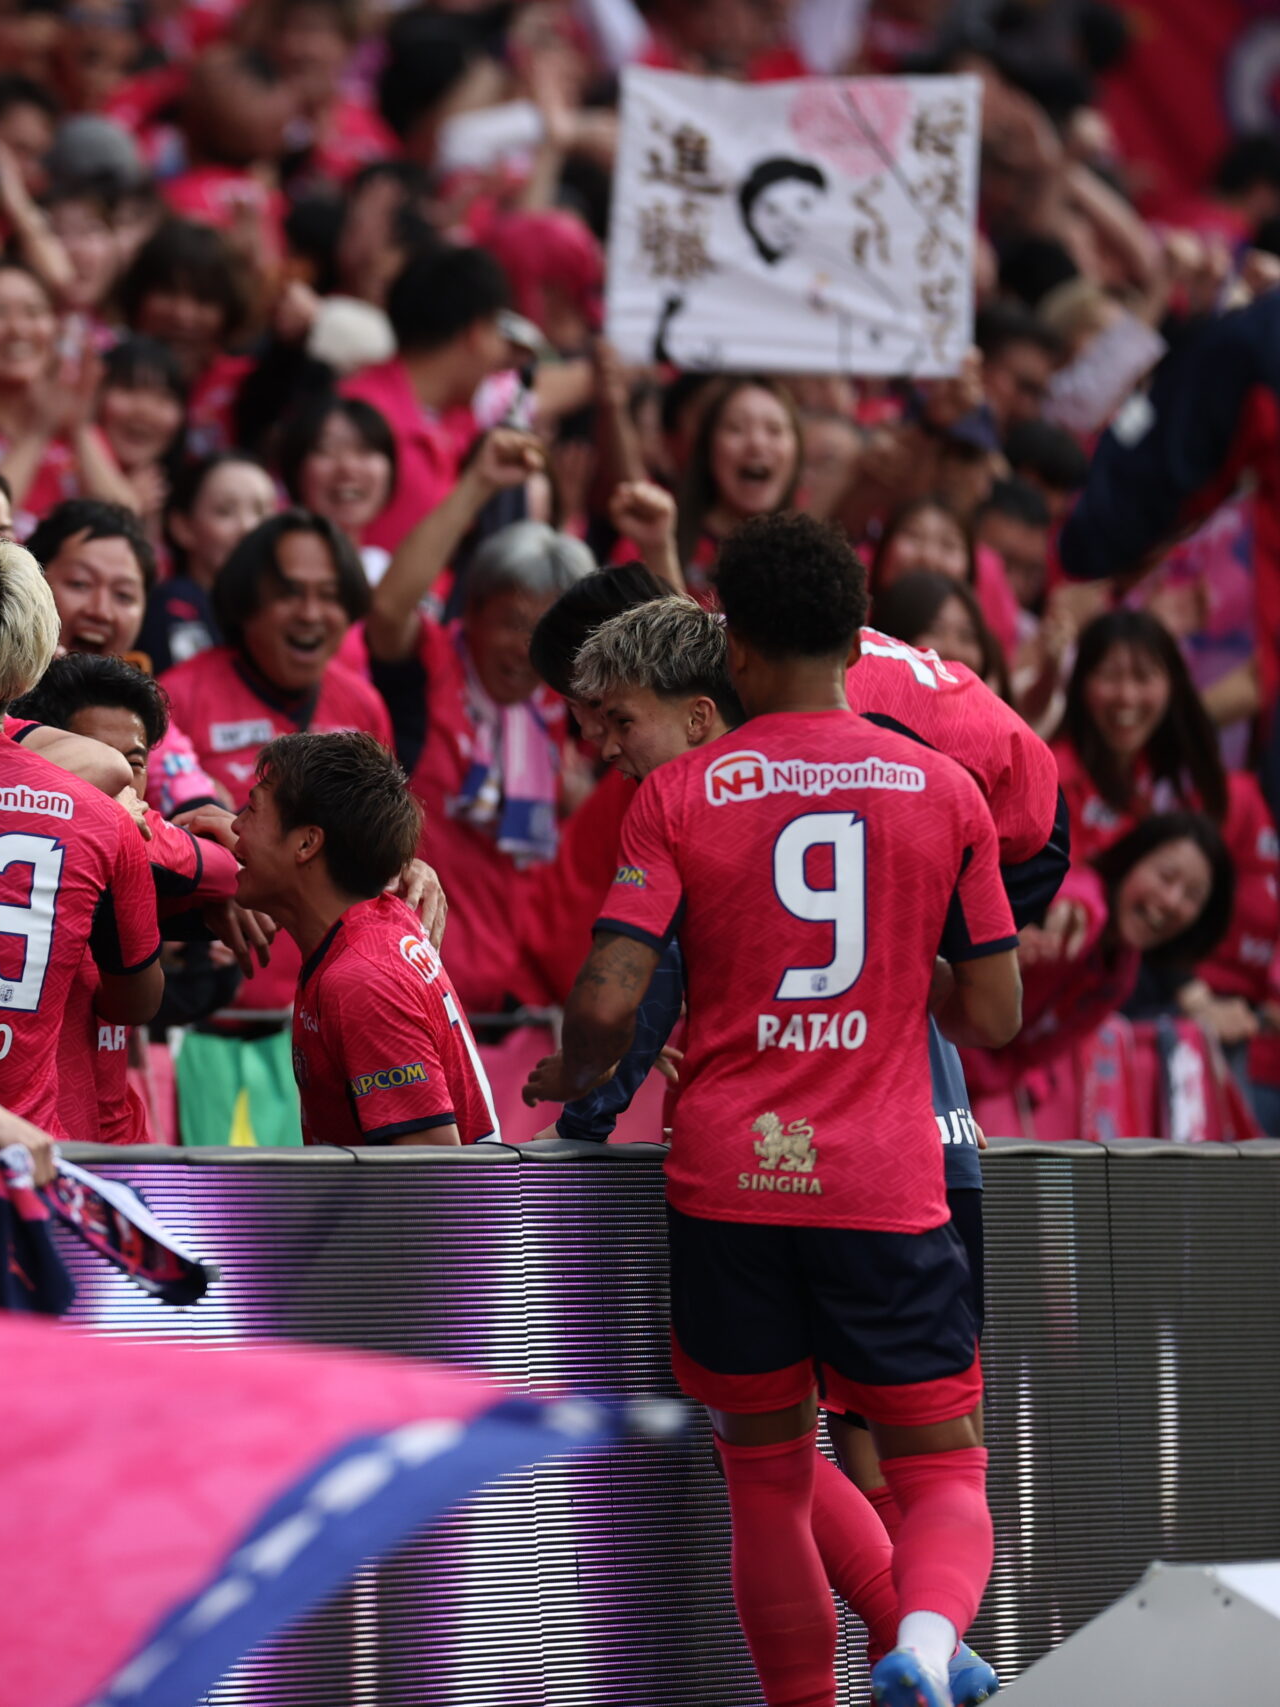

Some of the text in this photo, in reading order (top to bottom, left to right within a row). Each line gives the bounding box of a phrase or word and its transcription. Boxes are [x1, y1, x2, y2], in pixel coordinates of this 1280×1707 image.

[772, 763, 921, 791] Nipponham
[772, 810, 867, 1001] 9
[757, 1010, 868, 1052] RATAO
[737, 1172, 823, 1195] SINGHA
